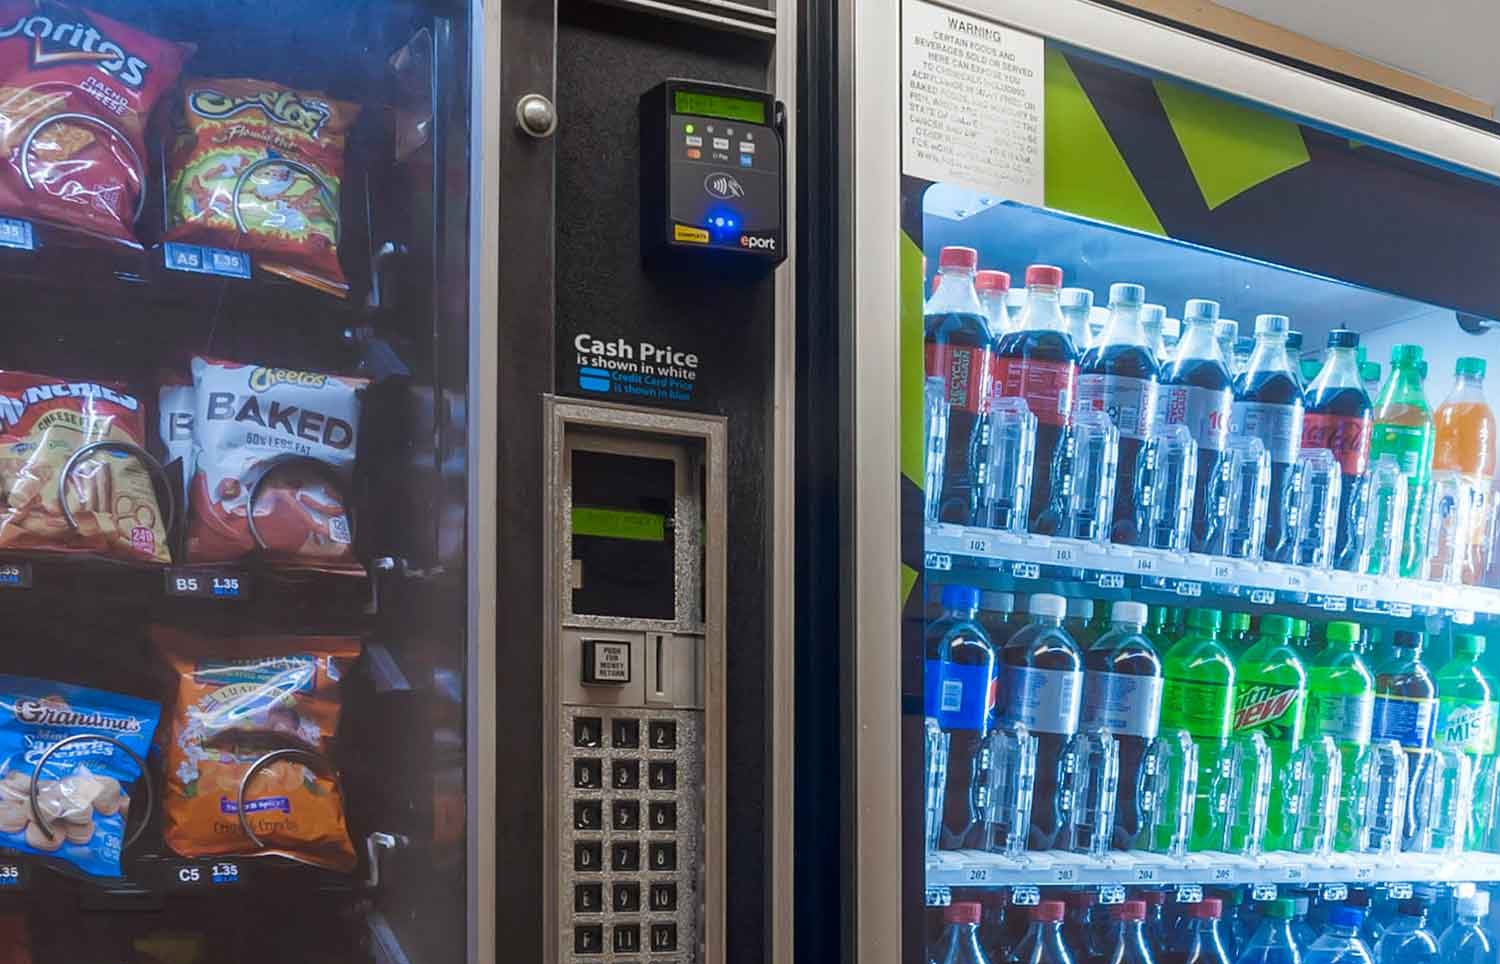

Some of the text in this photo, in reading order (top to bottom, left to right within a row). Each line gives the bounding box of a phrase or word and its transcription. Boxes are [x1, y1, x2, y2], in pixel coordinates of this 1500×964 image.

[947, 17, 1000, 42] WARNING
[933, 32, 968, 48] CERTAIN
[1000, 51, 1016, 62] AND
[79, 81, 126, 115] CHEESE
[196, 90, 325, 134] Ctos
[741, 236, 776, 250] eport
[177, 253, 199, 267] A5
[213, 253, 239, 268] 1.35
[574, 333, 698, 368] Cash Price
[592, 355, 638, 373] shown
[641, 362, 654, 375] in
[657, 365, 696, 380] white
[207, 391, 353, 449] BAKED
[970, 540, 986, 551] 102
[1056, 549, 1071, 561] 103
[1137, 559, 1152, 570] 104
[1215, 566, 1229, 577] 105
[176, 578, 198, 591] B5
[213, 578, 239, 590] 1.35
[15, 698, 141, 732] Grandma's
[580, 727, 664, 744] A 1 2
[581, 768, 663, 784] B 3 4
[582, 809, 664, 825] C 5 6
[582, 850, 665, 865] D 7 8
[179, 869, 199, 883] C5
[212, 866, 239, 879] 1.35
[970, 870, 986, 880] 202
[1057, 870, 1073, 880] 203
[1138, 870, 1153, 880] 204
[1216, 870, 1230, 879] 205
[583, 889, 668, 907] E 9 10
[584, 930, 668, 947] F 11 12
